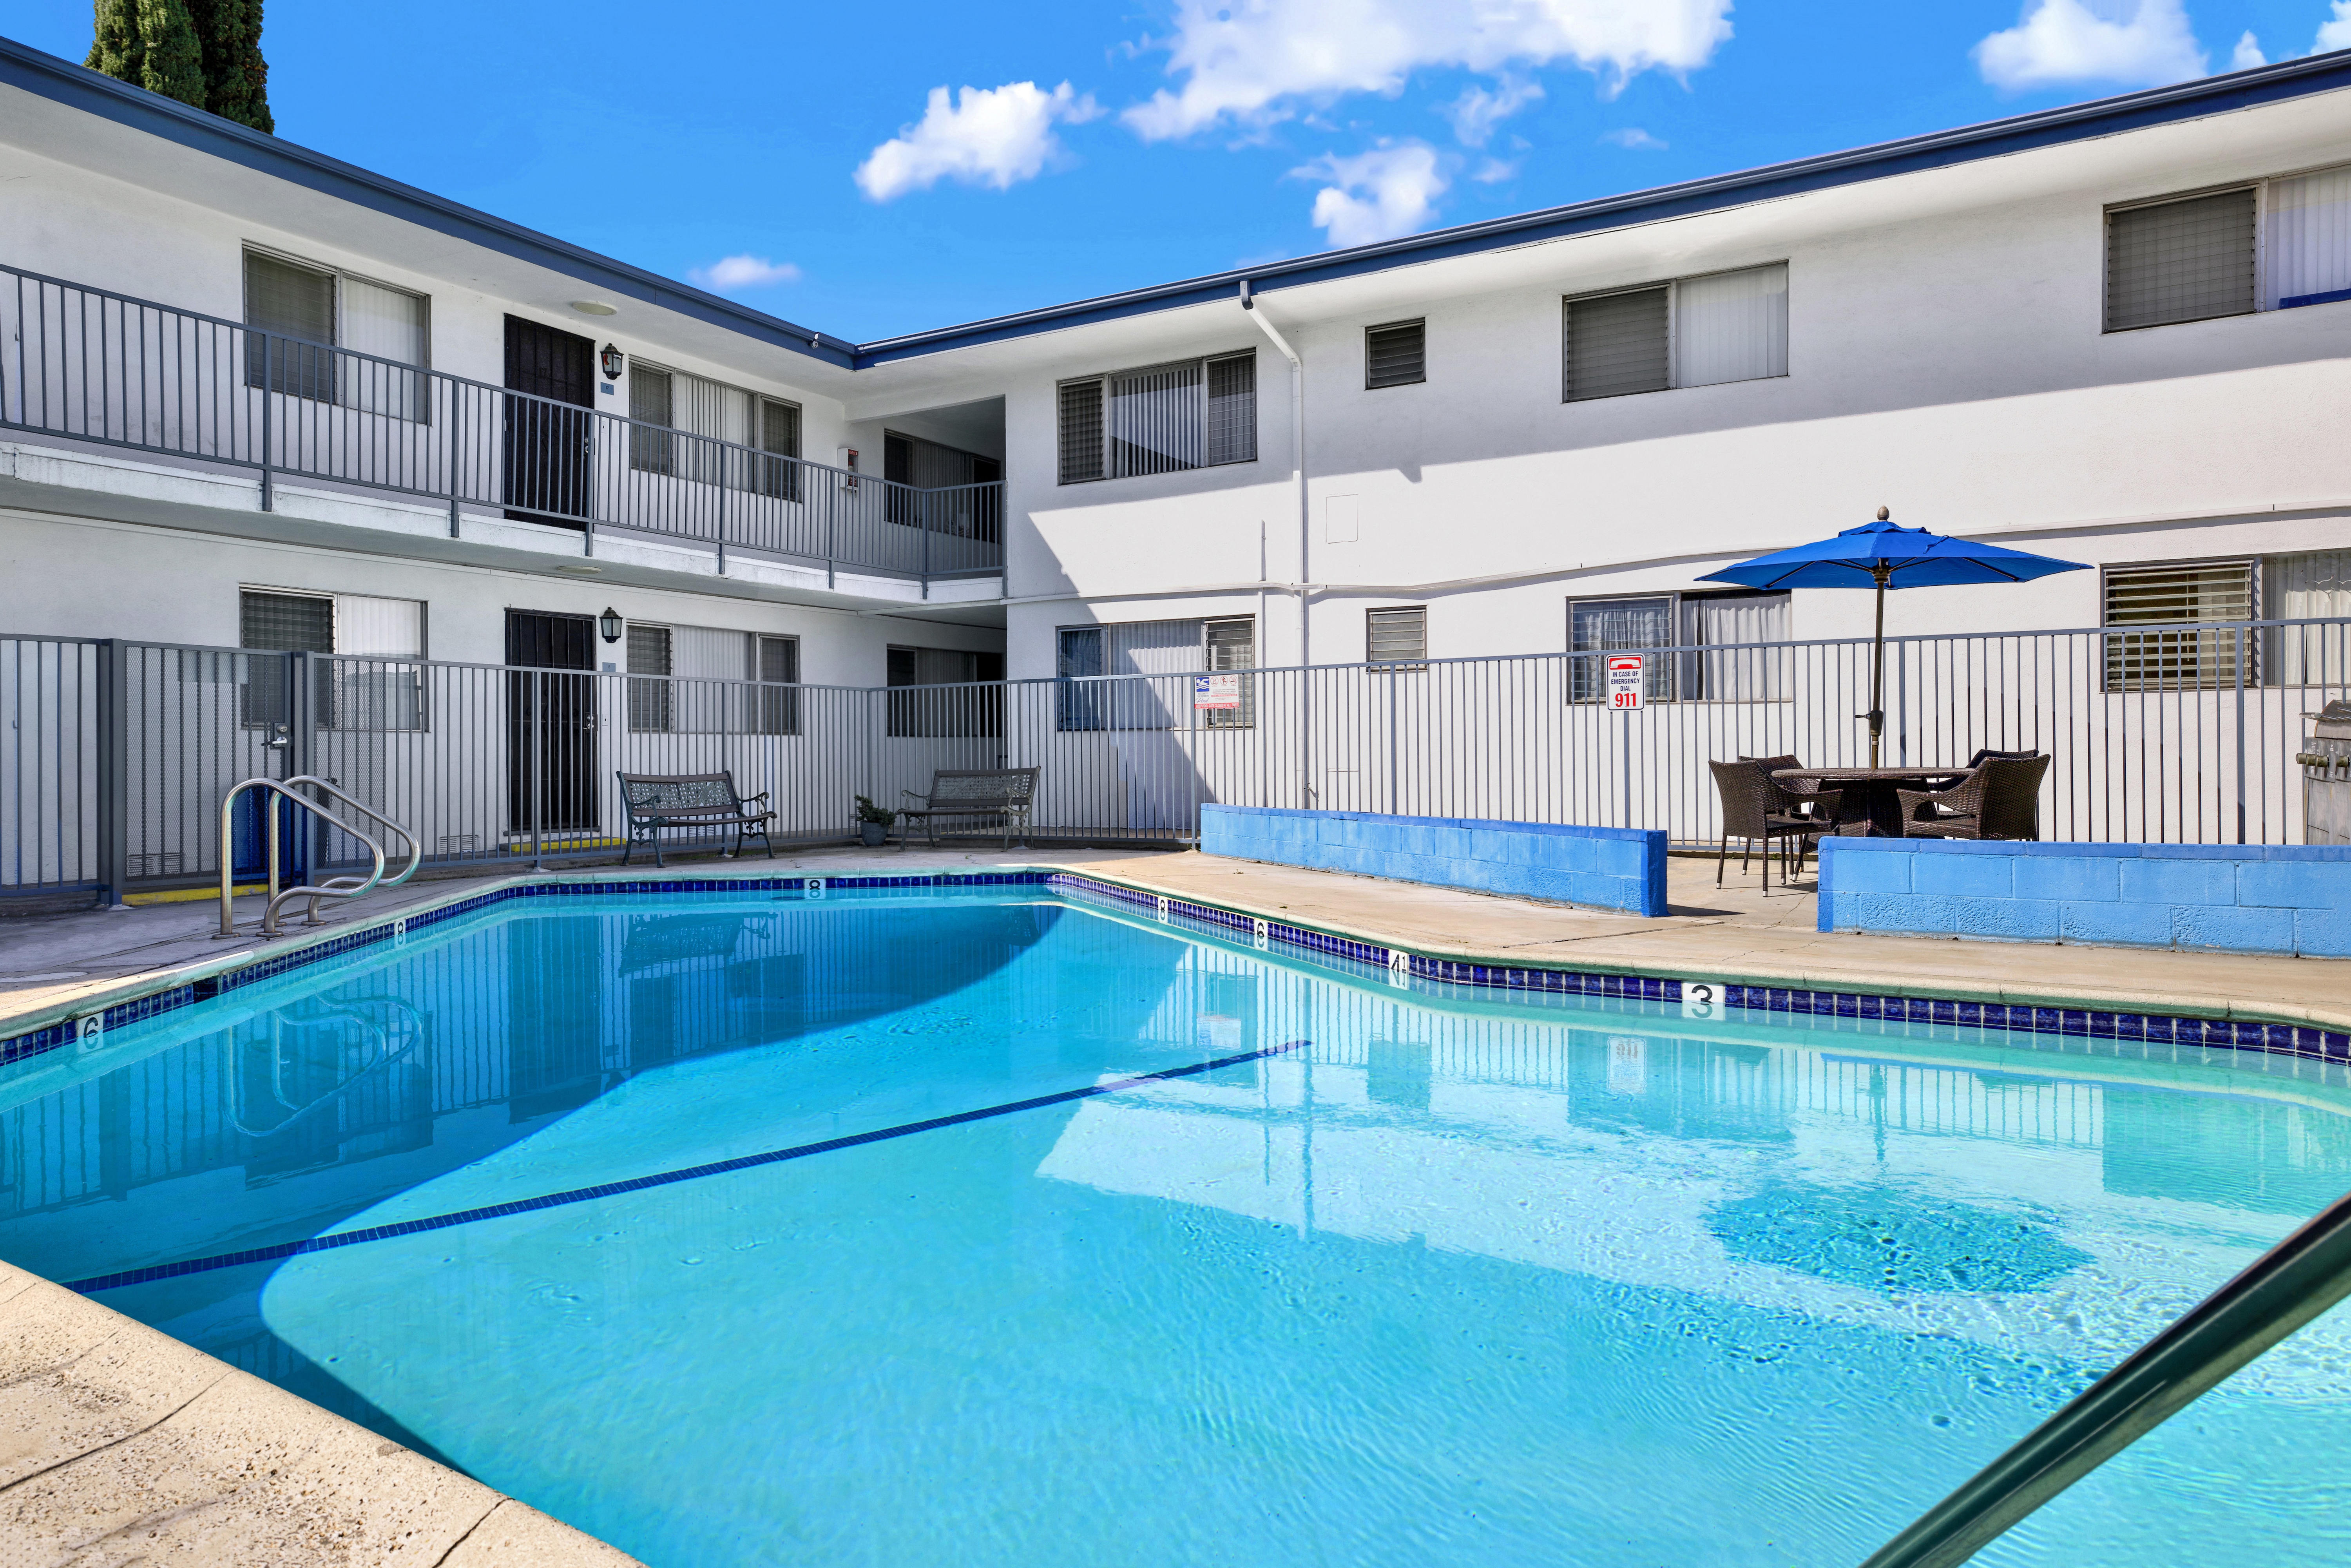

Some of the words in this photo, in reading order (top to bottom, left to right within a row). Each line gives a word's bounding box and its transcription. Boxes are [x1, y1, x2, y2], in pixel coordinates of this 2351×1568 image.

[1615, 693, 1636, 707] 911
[1257, 922, 1264, 937] 6
[1691, 985, 1714, 1005] 3
[83, 1017, 98, 1038] 6
